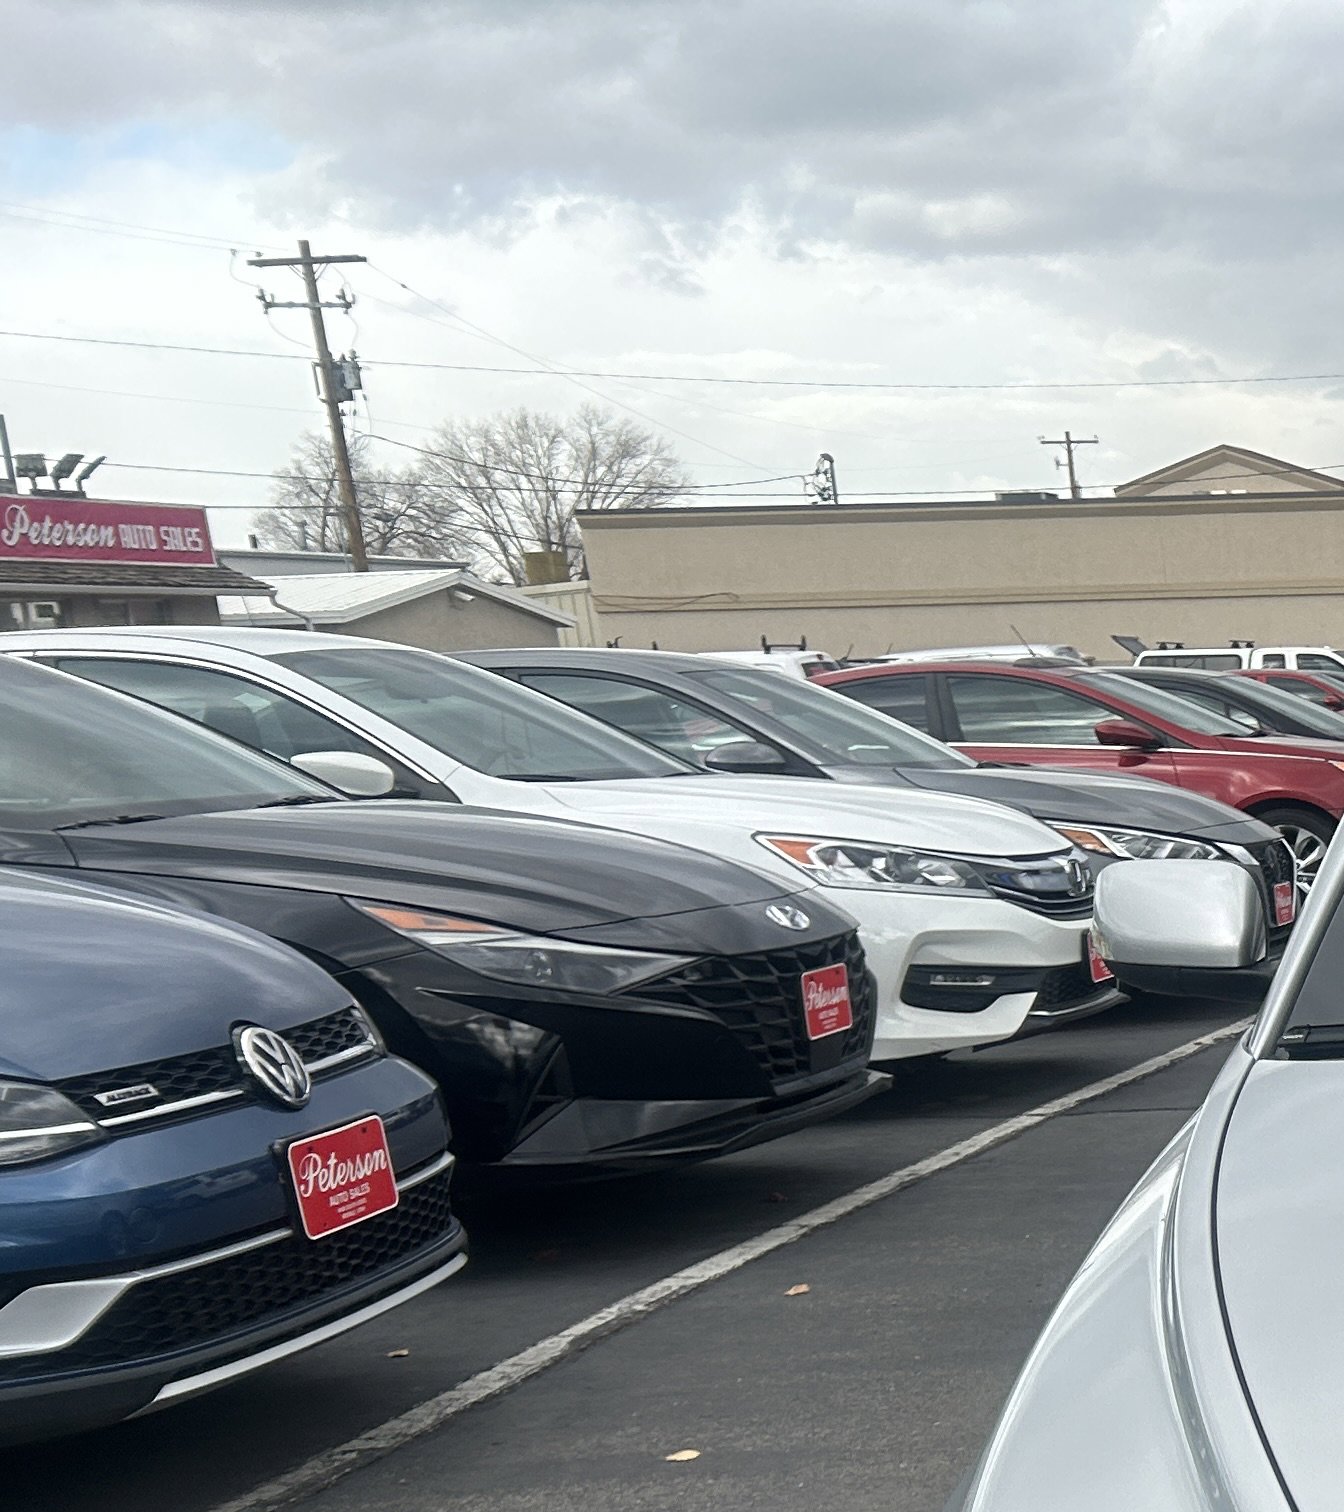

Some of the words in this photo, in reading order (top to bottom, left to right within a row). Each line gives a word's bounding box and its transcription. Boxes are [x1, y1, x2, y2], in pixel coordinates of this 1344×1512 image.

[1, 503, 116, 548] Peterson
[118, 524, 157, 549] AUTO
[159, 525, 203, 552] SALES
[299, 1149, 387, 1198] Peterson
